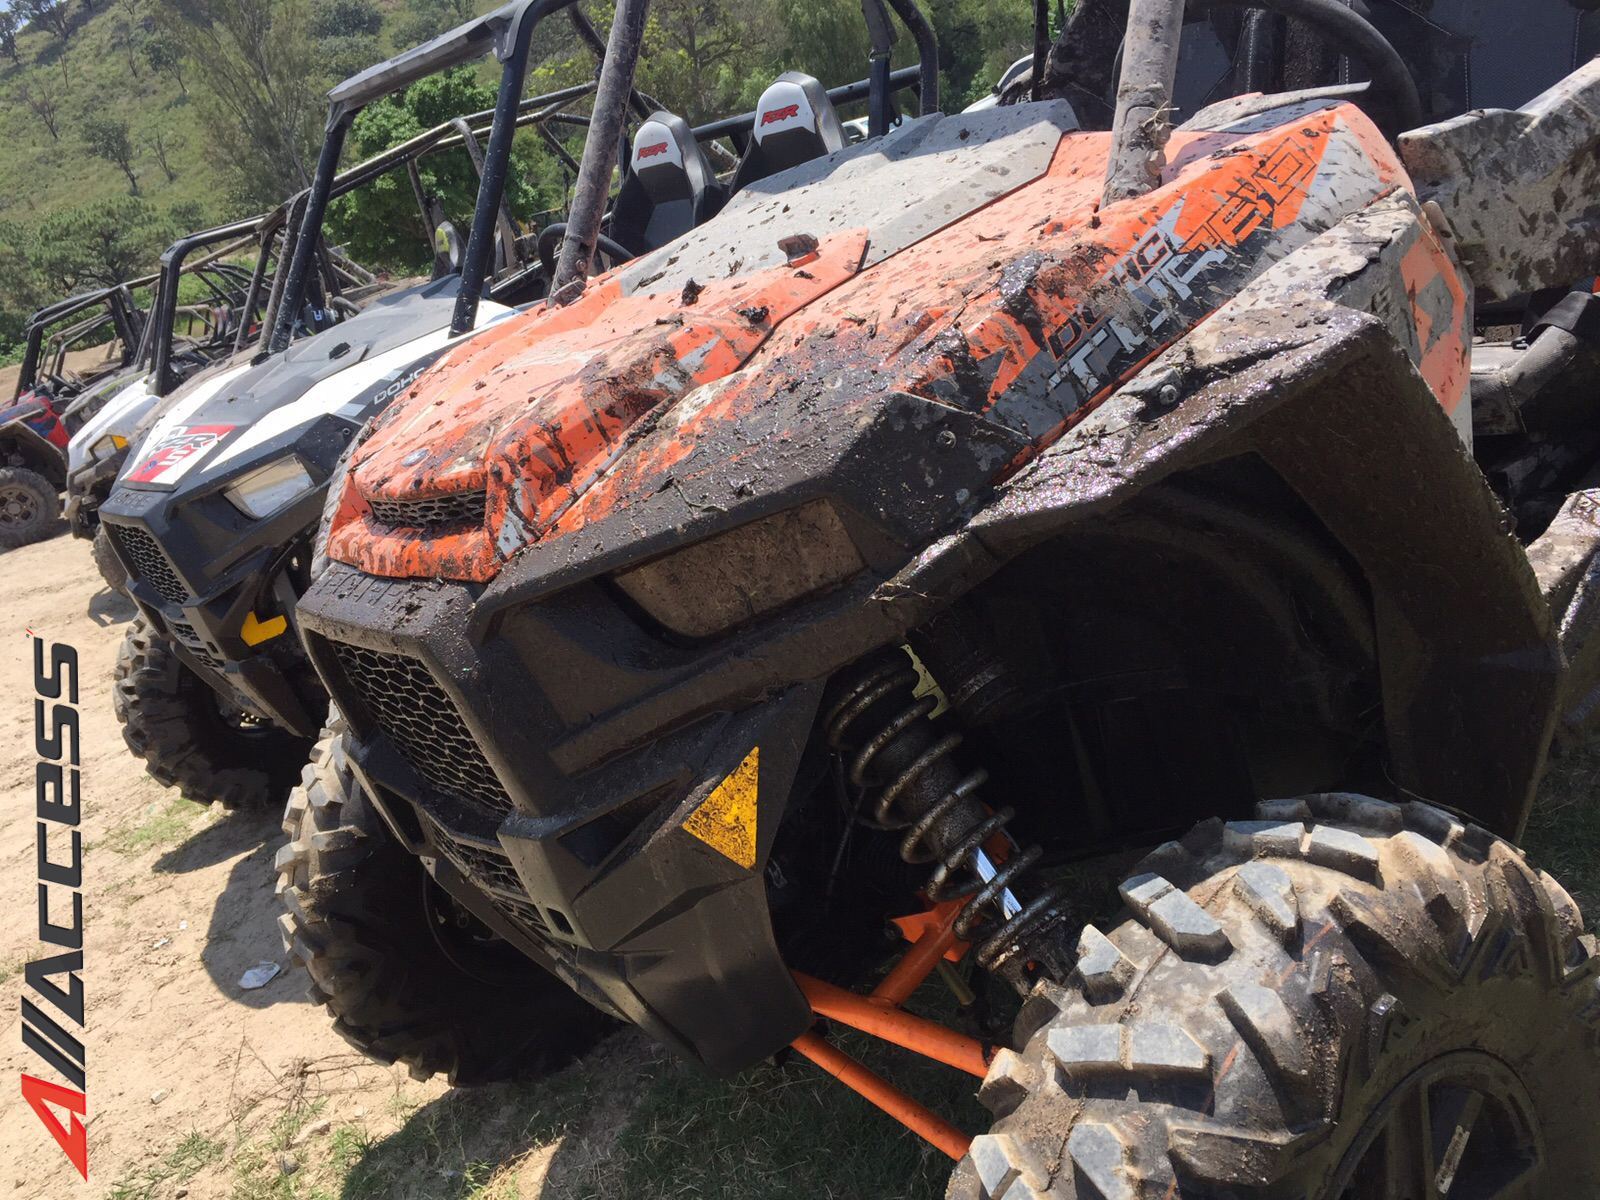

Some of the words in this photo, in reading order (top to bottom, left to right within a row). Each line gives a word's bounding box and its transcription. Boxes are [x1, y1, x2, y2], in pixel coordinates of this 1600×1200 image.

[760, 104, 800, 127] RZR
[637, 141, 668, 161] RZR
[374, 366, 425, 405] DOHC
